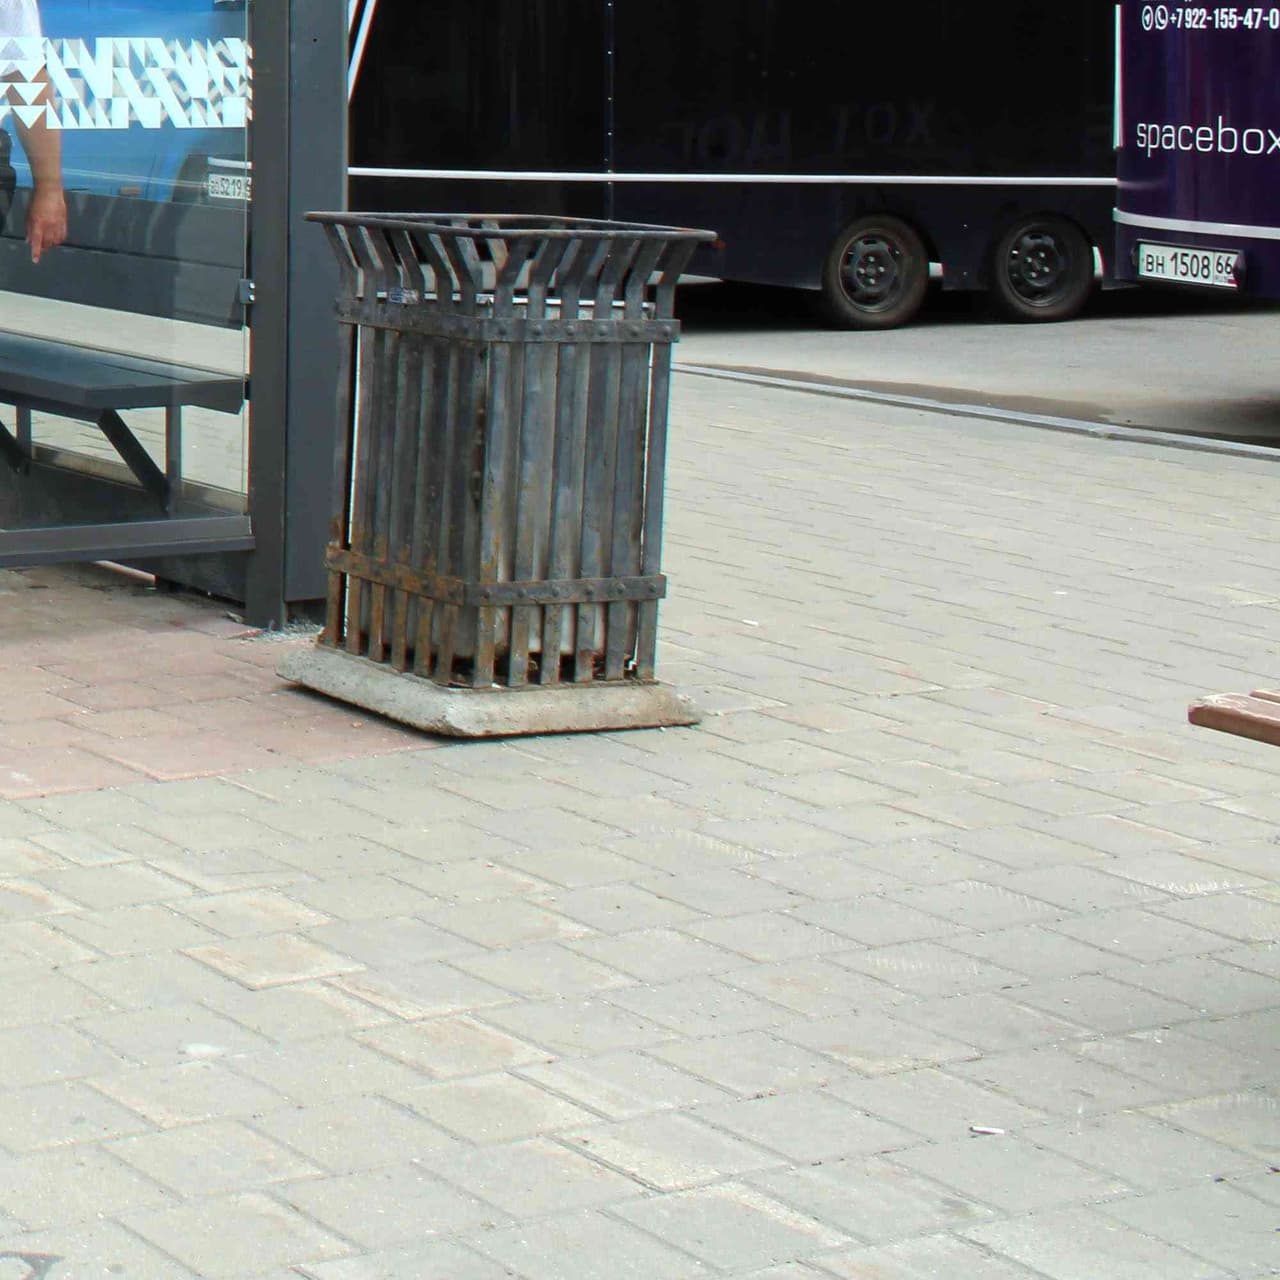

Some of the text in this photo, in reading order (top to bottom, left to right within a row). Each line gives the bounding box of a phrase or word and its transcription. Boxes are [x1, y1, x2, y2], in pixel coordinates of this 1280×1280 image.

[1136, 114, 1280, 158] spacebox
[1145, 252, 1234, 279] ВН 1508 66
